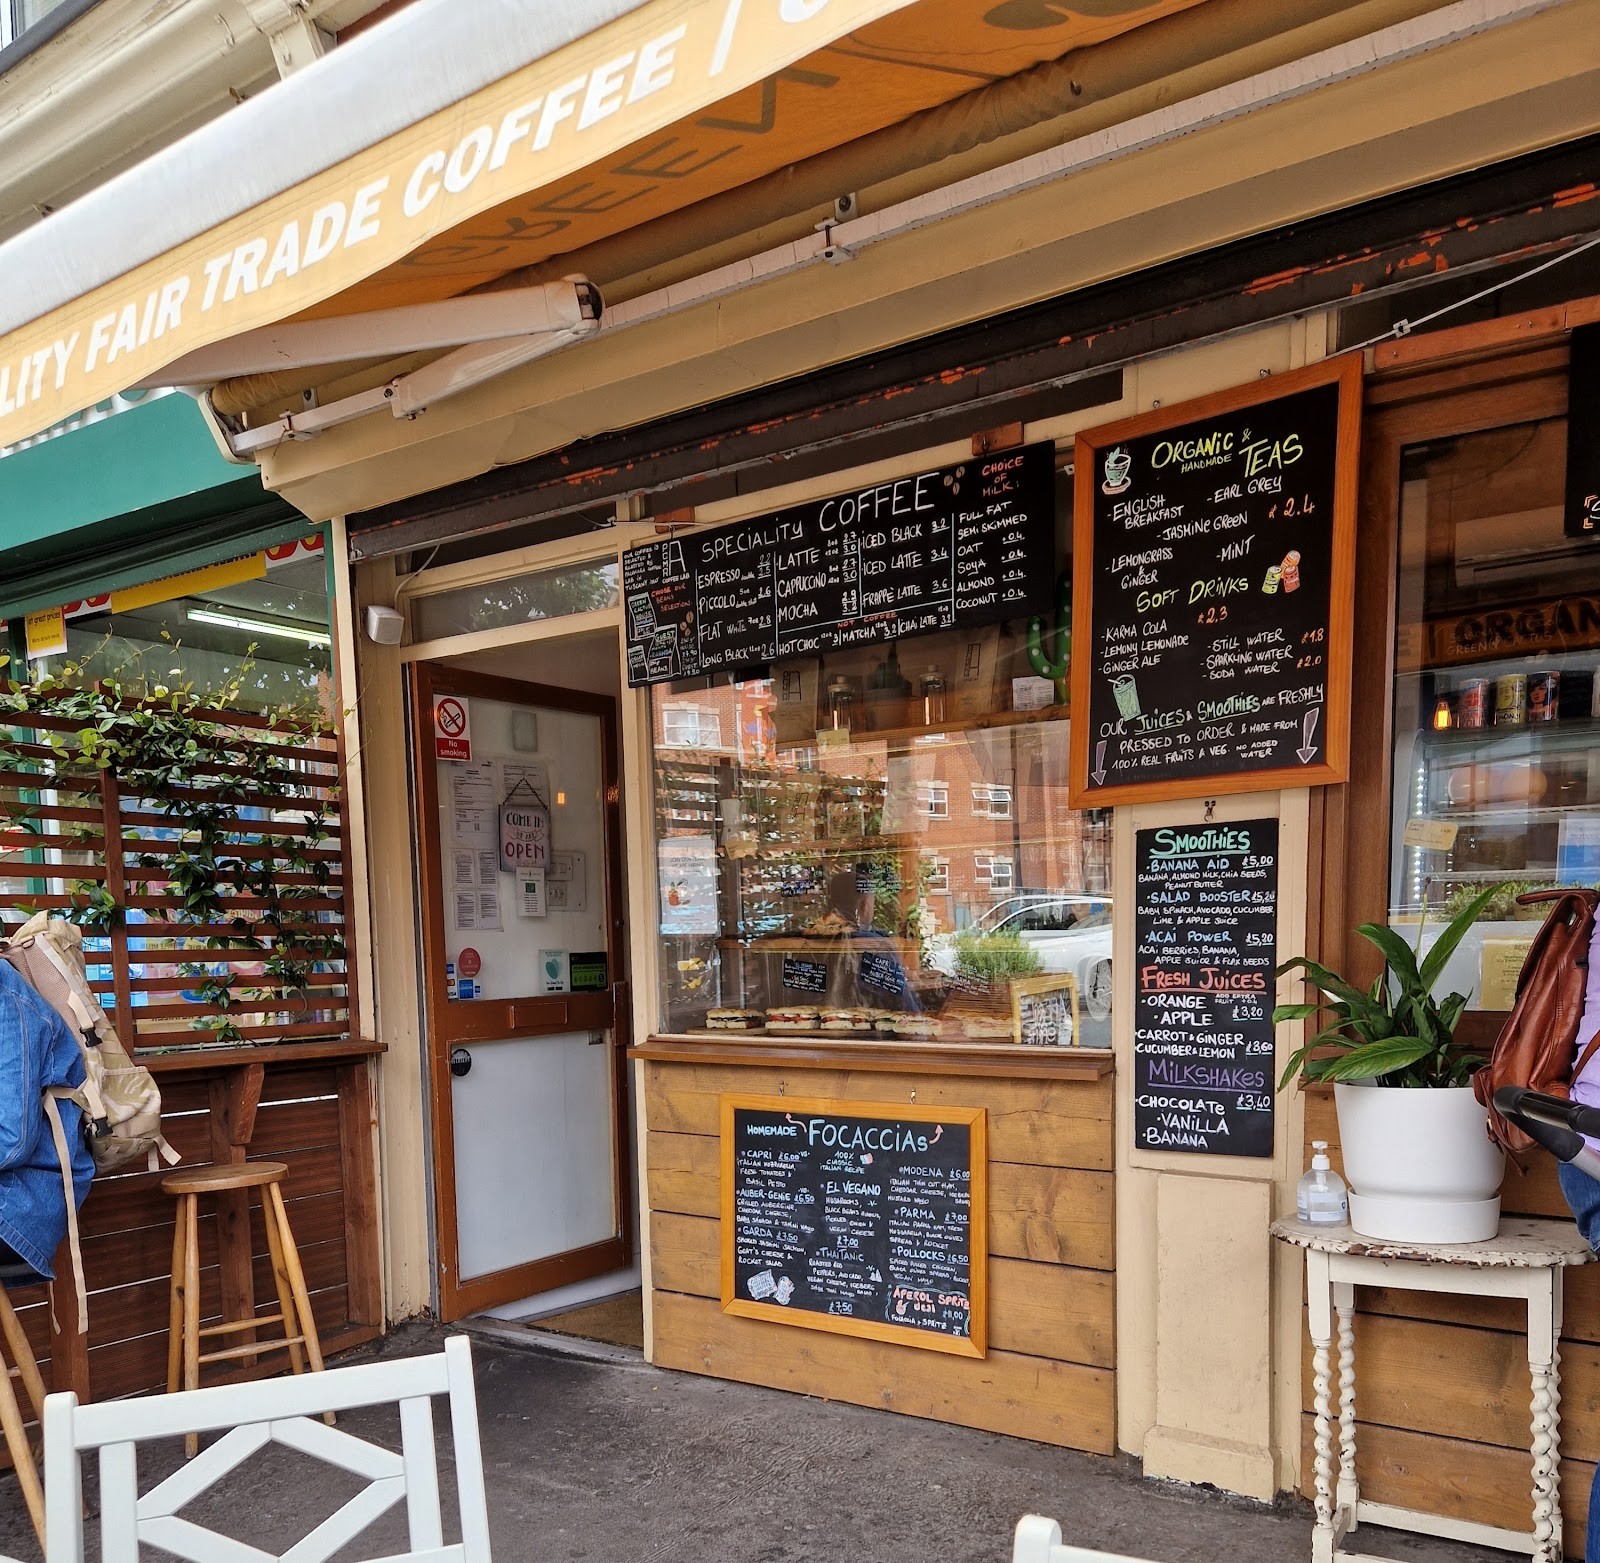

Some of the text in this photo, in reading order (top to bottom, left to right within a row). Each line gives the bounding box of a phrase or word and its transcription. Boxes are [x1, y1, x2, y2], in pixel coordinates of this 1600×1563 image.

[85, 274, 191, 373] FAIR
[201, 175, 390, 312] TRADE
[403, 23, 688, 218] COFFEE
[1151, 429, 1303, 478] ORGANIC & TEAS
[981, 456, 1024, 476] CHOICE
[1181, 454, 1232, 473] HANDMADE
[994, 473, 1007, 483] OF
[1248, 476, 1282, 494] GREY
[702, 472, 940, 563] SPECIALITY COFFEE
[959, 501, 1012, 523] FULL FAT
[1125, 505, 1184, 529] BREAKFAST
[862, 531, 886, 548] ICED
[892, 524, 922, 542] BLACK
[958, 514, 1027, 540] SEMI SKIMMED
[957, 542, 983, 556] OAT
[778, 548, 820, 571] LATTE
[863, 558, 886, 575] ICED
[891, 551, 923, 569] LATTE
[957, 560, 986, 576] SOYA
[698, 568, 741, 588] ESPRESSO
[777, 572, 826, 598] CAPPUCCINO
[957, 577, 994, 592] ALMOND
[1121, 570, 1158, 590] GINGER
[897, 579, 948, 599] LATTE 3.6
[1137, 577, 1249, 613] SOFT DRINKS
[699, 593, 736, 614] PICCOLO
[956, 593, 998, 609] COCONUT
[777, 602, 818, 622] MOCHA
[838, 612, 897, 628] NOT COFFEE
[700, 615, 771, 642] FLAT WHITE 2.8
[920, 615, 937, 629] LATTE
[1143, 619, 1167, 636] COLA
[842, 626, 877, 643] MATCHA
[1141, 635, 1189, 651] LEMONADE
[1247, 628, 1285, 646] WATER
[779, 637, 819, 655] HOT CHOC
[1256, 645, 1293, 662] WATER
[701, 643, 774, 668] LONG BLACK 2.6
[1141, 654, 1161, 667] ALE
[1245, 662, 1280, 675] WATER
[1101, 683, 1324, 738] OUR JUICES SMOOTHIES ARE FRESHLY
[449, 740, 458, 748] No
[1120, 719, 1298, 754] PRESSED TO ORDER MADE FROM
[440, 749, 468, 758] smoking
[1112, 757, 1138, 769] 100%
[1141, 755, 1161, 766] REAL
[1165, 749, 1194, 763] FRUITS
[1236, 743, 1247, 751] NO
[1251, 739, 1278, 750] ADDED
[1241, 748, 1272, 759] WATER
[506, 812, 531, 827] COME
[1150, 827, 1250, 855] SMOOTHIES
[505, 842, 544, 859] OPEN
[1151, 855, 1230, 872] BANANA AID
[1151, 890, 1251, 903] SALAD BOOSTER
[1148, 927, 1232, 943] ACAI POWER
[1154, 956, 1181, 964] APPLE
[1214, 956, 1221, 964] &
[1243, 957, 1270, 965] SEEDS
[1141, 966, 1266, 990] FRESH JUICES
[1147, 994, 1207, 1009] ORANGE
[1160, 1012, 1214, 1026] APPLE
[1150, 1058, 1265, 1089] MILKSHAKES
[1138, 1095, 1225, 1116] CHOCOLATE
[1161, 1112, 1230, 1135] VANILLA
[747, 1119, 928, 1153] HOMEMADE FOCACCIAS
[1147, 1127, 1209, 1148] BANANA
[747, 1148, 772, 1159] CAPRI
[903, 1167, 943, 1178] MODENA
[826, 1180, 881, 1196] EL VEGANO
[900, 1206, 936, 1220] PARMA
[742, 1226, 773, 1238] GARDA
[897, 1246, 945, 1262] POLLOCKS
[893, 1287, 933, 1303] APEROL
